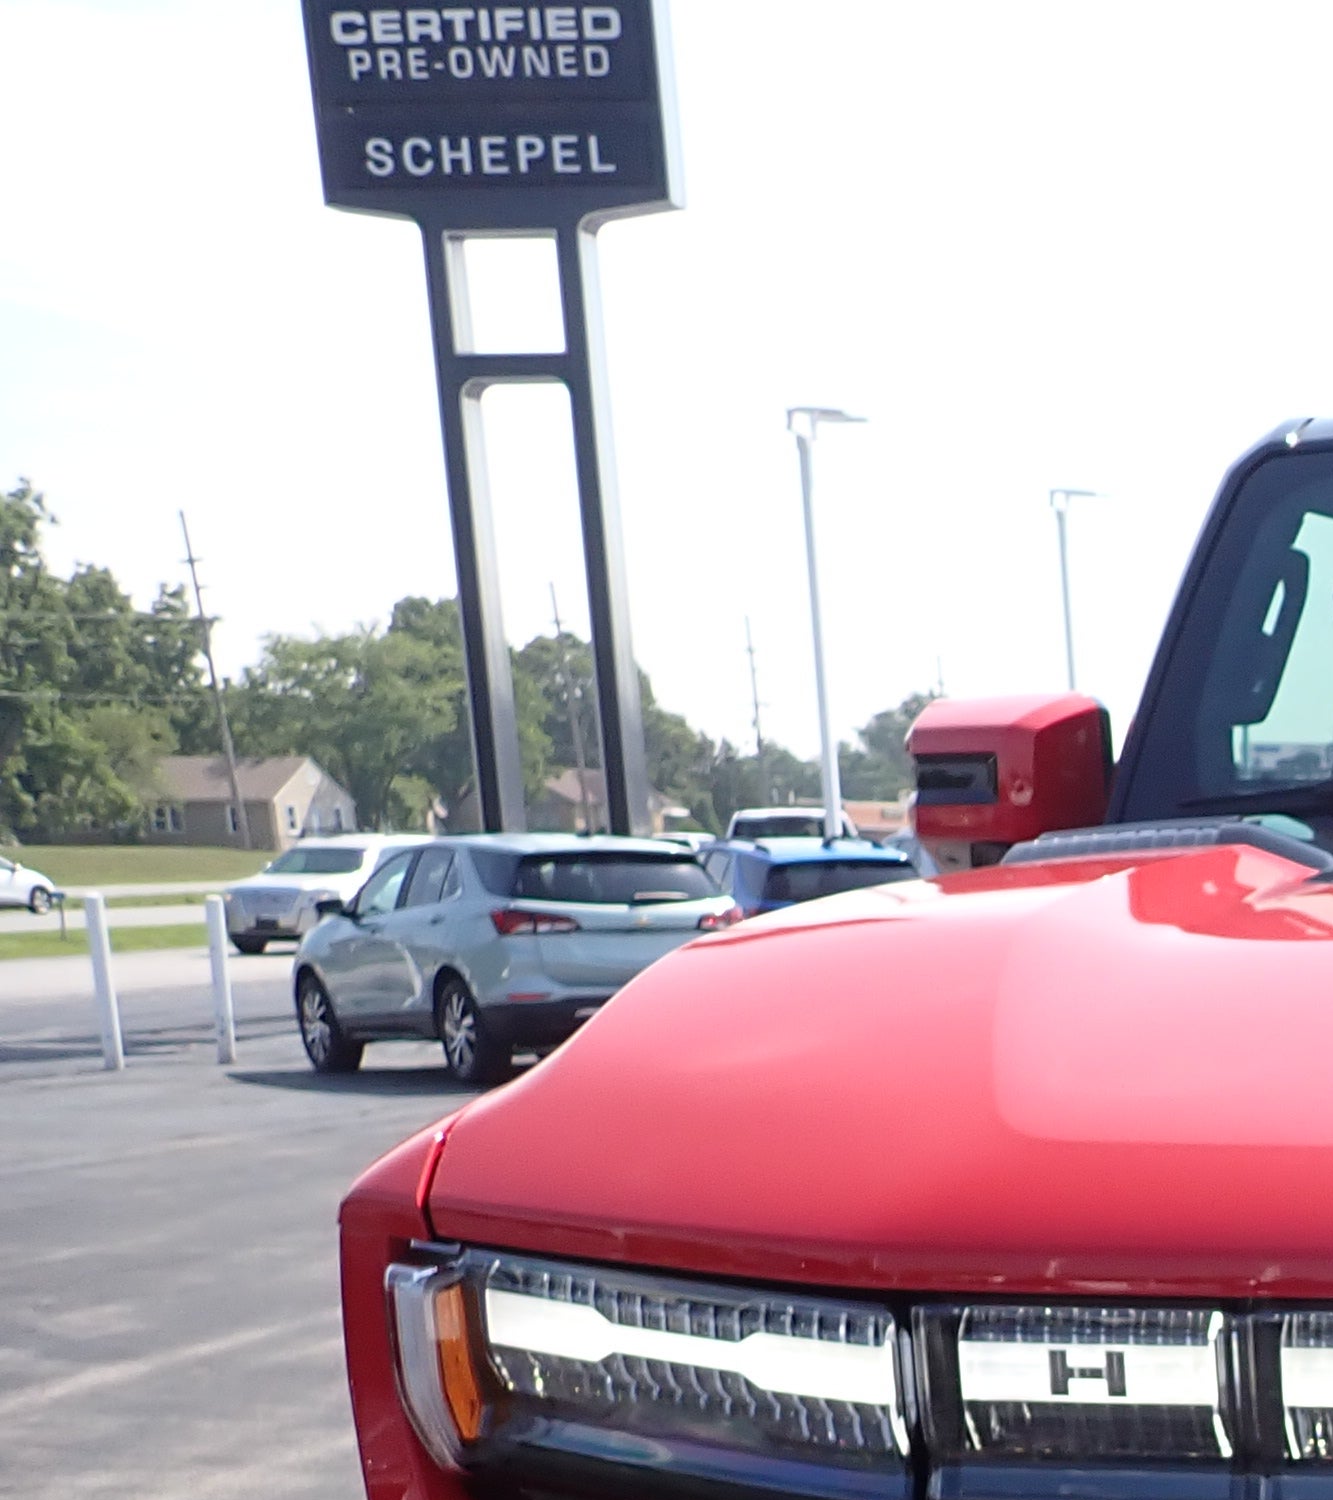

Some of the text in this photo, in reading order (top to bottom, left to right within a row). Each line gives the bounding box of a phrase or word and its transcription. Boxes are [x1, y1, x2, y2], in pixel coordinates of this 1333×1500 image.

[330, 7, 622, 45] CERTIFIED
[347, 45, 611, 81] PRE-OWNED
[365, 134, 618, 177] SCHEPEL
